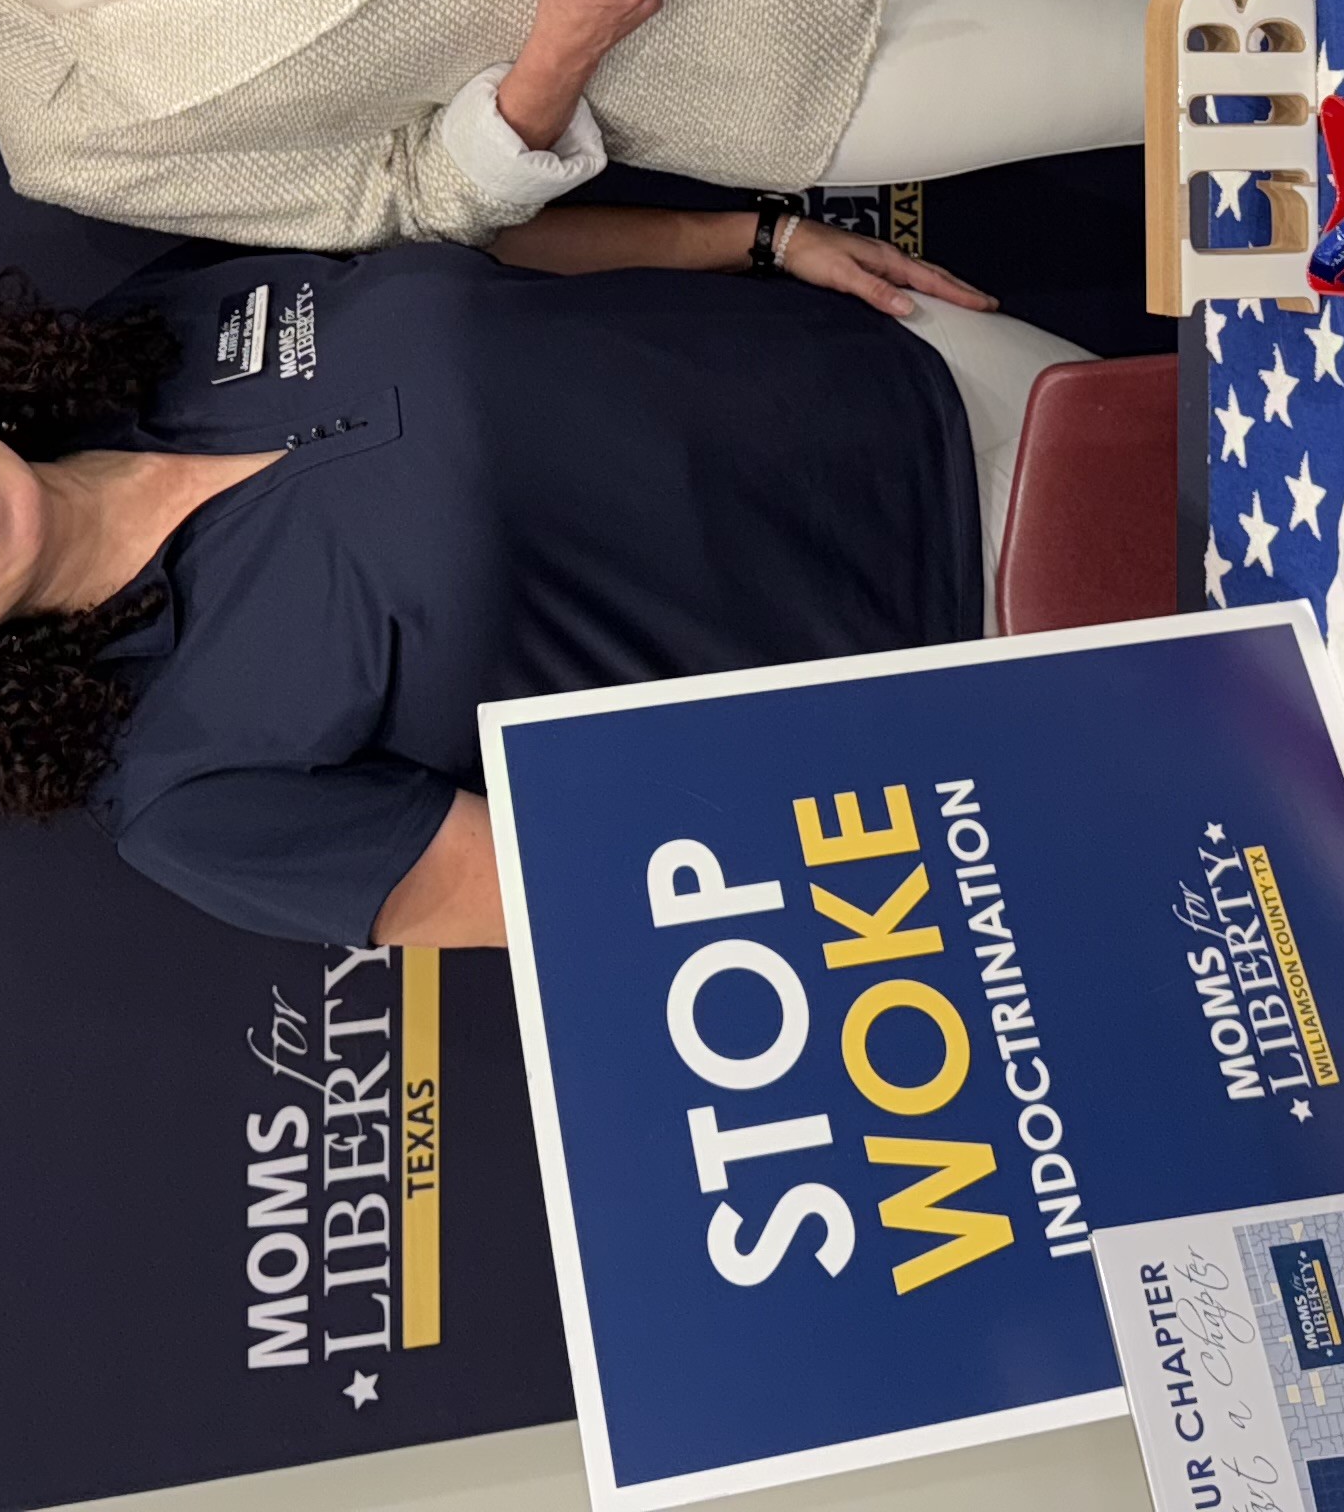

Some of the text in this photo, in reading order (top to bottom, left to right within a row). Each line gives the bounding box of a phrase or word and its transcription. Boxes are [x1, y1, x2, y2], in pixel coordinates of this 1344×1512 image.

[226, 314, 241, 358] LIBERTY
[279, 306, 299, 378] MOMS for
[296, 288, 317, 372] LIBERTY
[792, 784, 1016, 1296] WOKE
[935, 777, 1091, 1259] INDOCTRINATION
[1186, 946, 1266, 1100] MOMS
[1198, 846, 1312, 1094] LIBERTY
[1281, 960, 1333, 1080] WILLIAMSON
[646, 838, 856, 1287] STOP
[407, 1078, 436, 1199] TEXAS
[247, 1105, 310, 1369] MOMS
[1297, 1259, 1333, 1347] LIBERTY
[1138, 1260, 1205, 1442] CHAPTER
[1173, 1243, 1256, 1387] Chapter
[1294, 1295, 1319, 1349] MOMS
